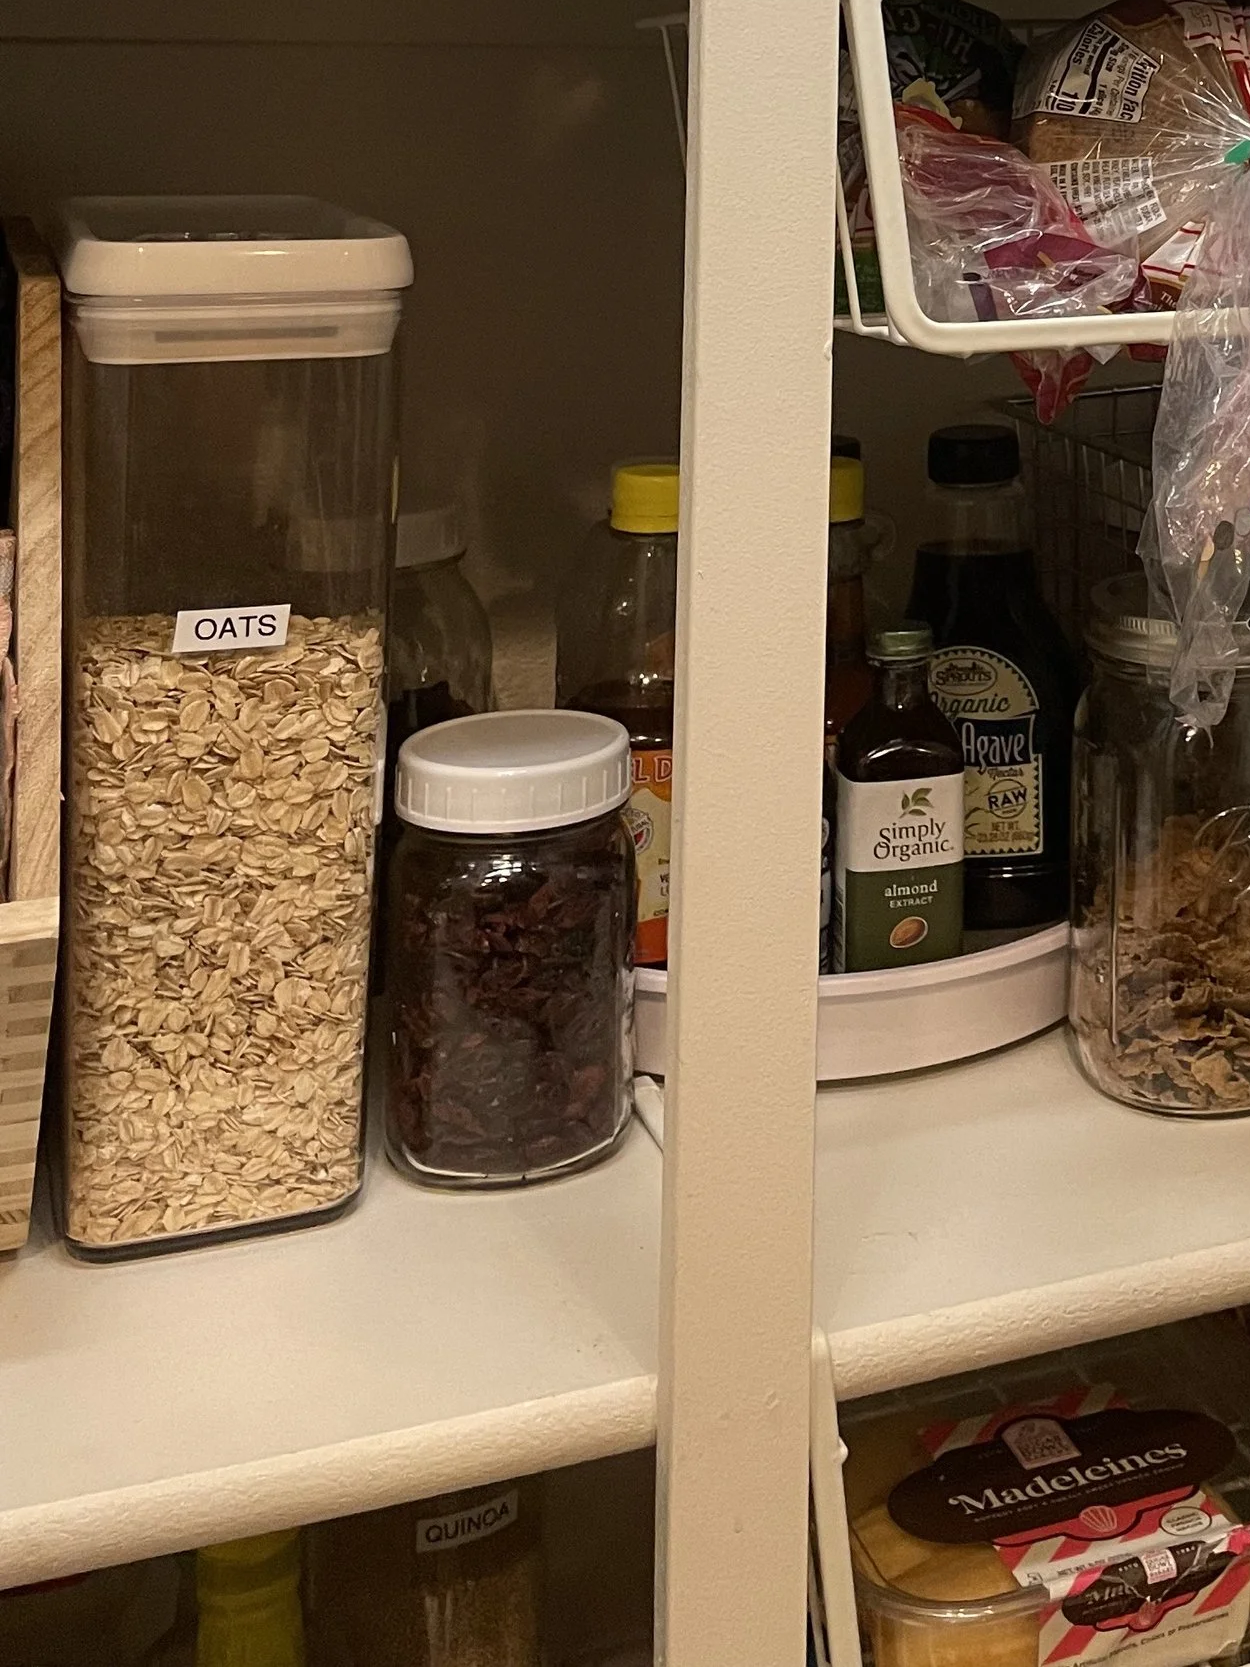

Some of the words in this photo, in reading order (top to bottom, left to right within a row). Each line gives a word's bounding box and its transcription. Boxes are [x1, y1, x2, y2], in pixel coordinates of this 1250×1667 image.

[193, 613, 278, 642] OATS
[935, 669, 992, 686] SPROUTS
[961, 721, 1026, 776] Agave
[987, 786, 1028, 811] RAW
[879, 817, 947, 844] Simply
[873, 839, 950, 863] Organic
[884, 880, 939, 898] almond
[889, 895, 934, 910] EXTRACT
[948, 1443, 1188, 1516] Madeleines
[424, 1500, 511, 1545] QUINOA
